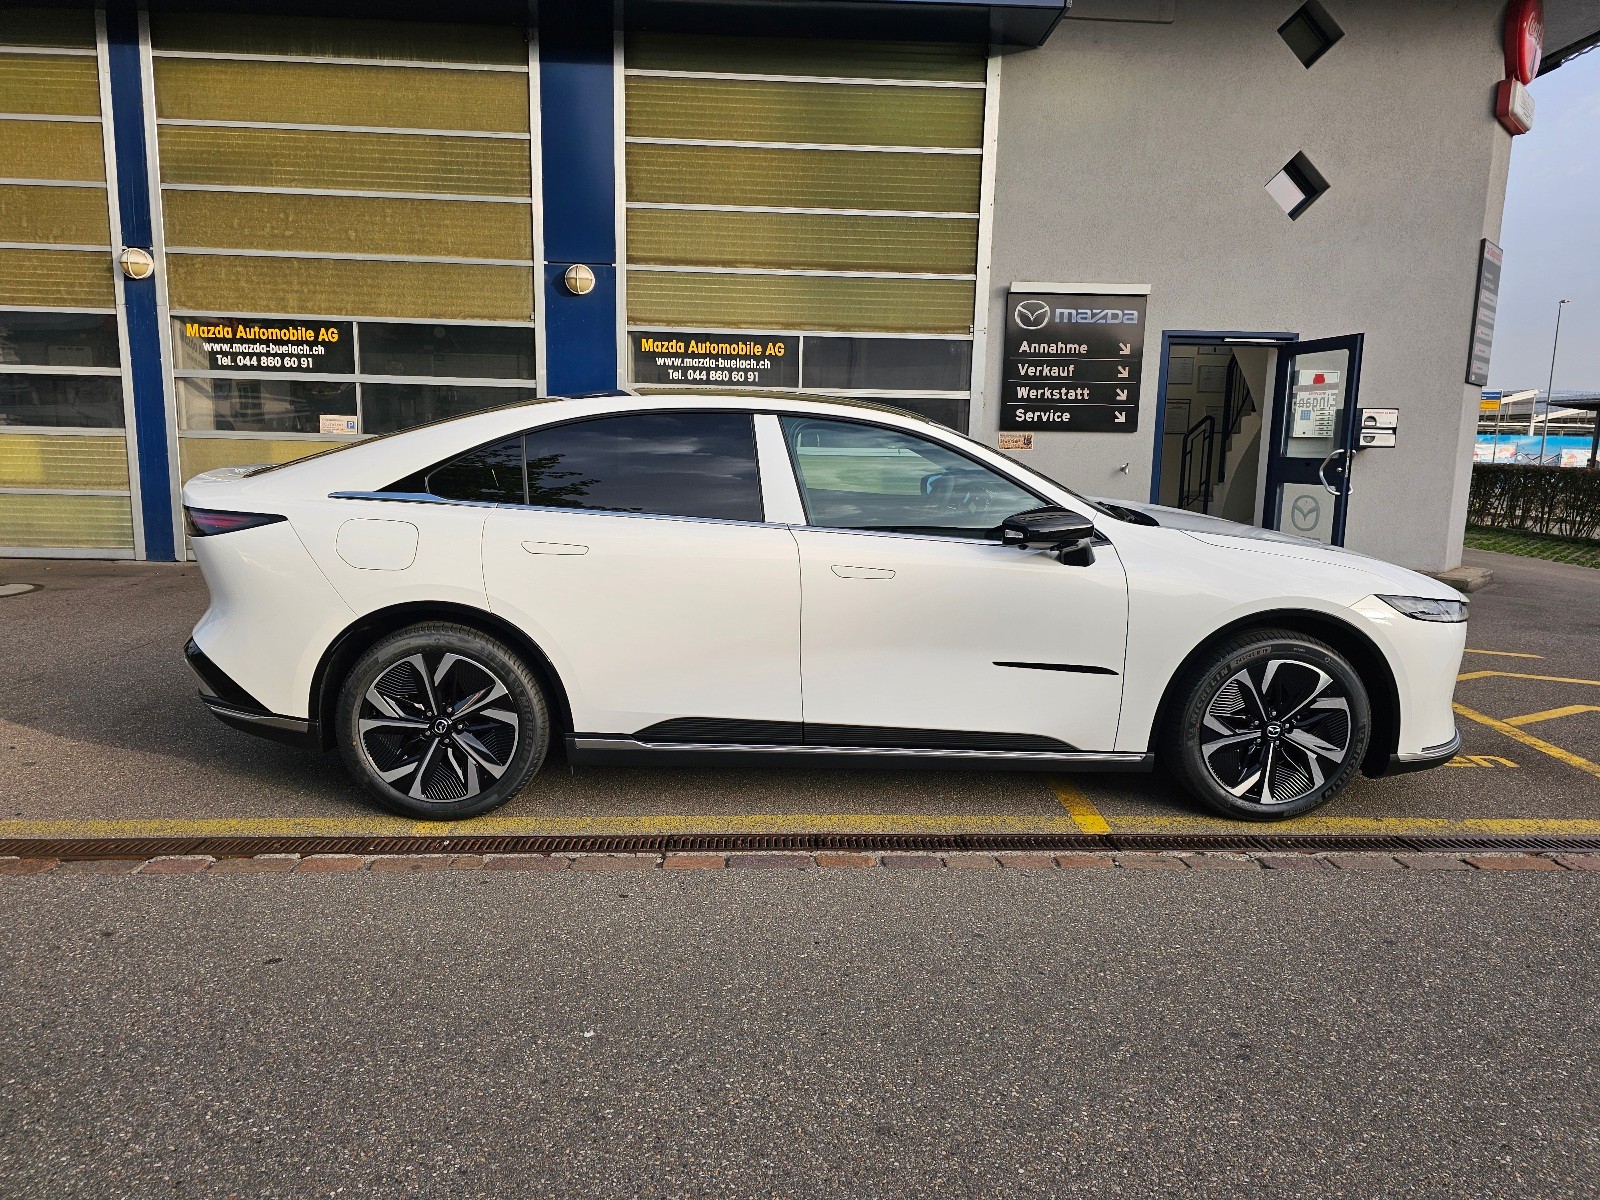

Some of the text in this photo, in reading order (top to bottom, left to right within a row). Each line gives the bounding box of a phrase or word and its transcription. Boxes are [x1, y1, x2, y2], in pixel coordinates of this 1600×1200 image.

[1055, 308, 1138, 324] mazda
[185, 323, 339, 342] Mazda Automobile AG
[203, 342, 325, 355] www.mazda-buelach.ch
[641, 338, 785, 357] Mazda Automobile AG
[1018, 341, 1088, 354] Annahme
[216, 355, 313, 368] Tel. 044 860 60 91
[656, 357, 771, 369] www.mazda-buelach.ch
[668, 370, 759, 382] Tel. 044 860 60 91
[1018, 363, 1075, 377] Verkauf
[1016, 386, 1090, 400] Werkstatt
[1015, 408, 1071, 422] Service
[1191, 668, 1229, 724] MICHELIN
